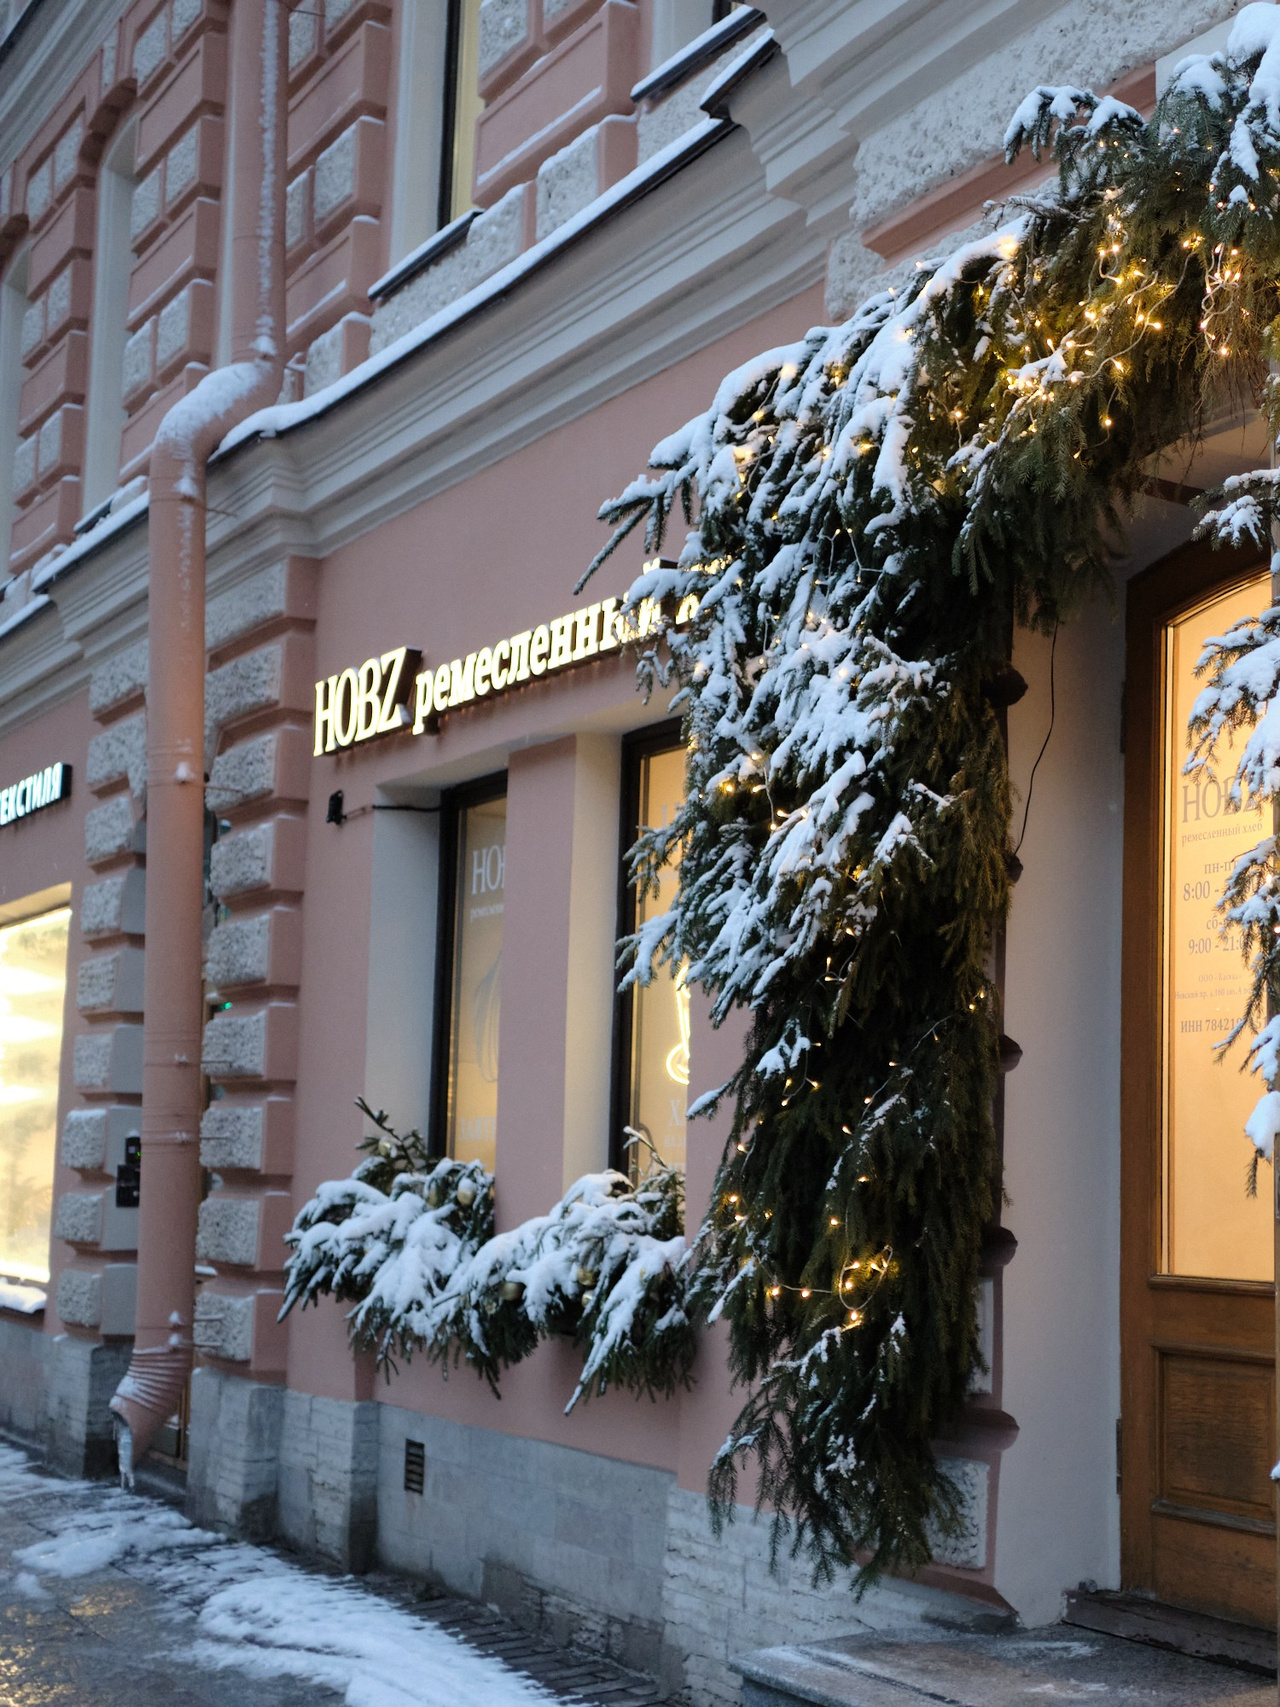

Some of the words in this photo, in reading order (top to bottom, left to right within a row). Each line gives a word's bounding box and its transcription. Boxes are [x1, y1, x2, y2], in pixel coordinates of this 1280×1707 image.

[1182, 824, 1241, 847] ремесленный
[1242, 818, 1263, 833] хлеб
[1183, 881, 1210, 901] 8:00
[1188, 938, 1212, 955] 9:00
[1180, 1019, 1203, 1033] ИНН
